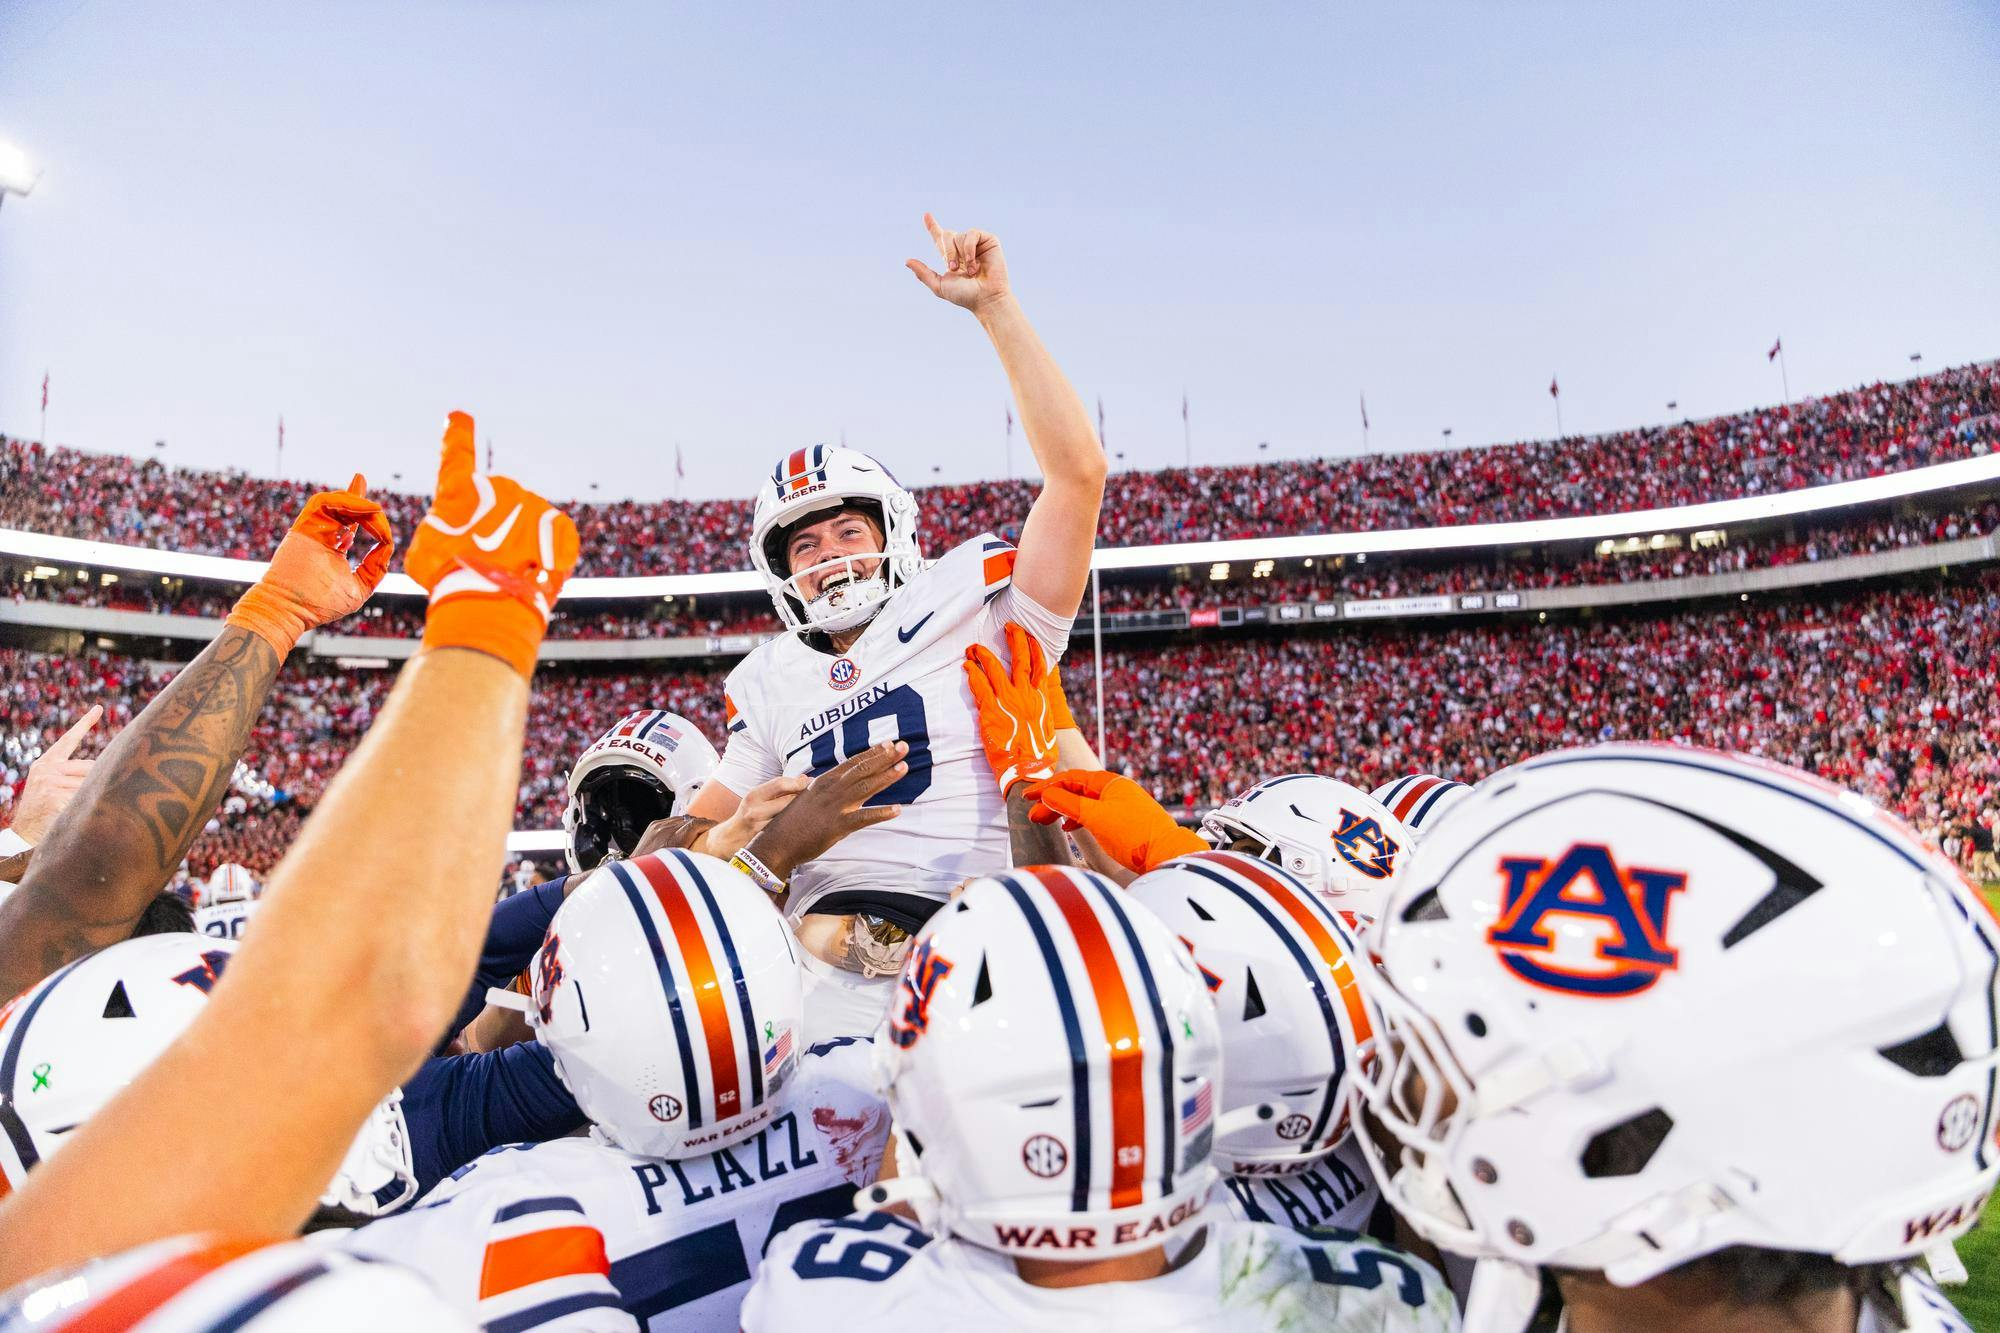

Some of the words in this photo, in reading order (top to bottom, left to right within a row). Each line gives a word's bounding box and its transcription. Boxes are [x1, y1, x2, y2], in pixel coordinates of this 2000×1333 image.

[781, 483, 826, 503] TIGERS
[832, 660, 854, 681] SEC
[800, 682, 889, 740] AUBURN
[608, 740, 667, 768] EAGLE
[650, 1096, 681, 1120] SEC
[719, 1090, 736, 1104] 52
[683, 1133, 719, 1148] WAR
[722, 1110, 768, 1136] EAGLE
[1279, 1115, 1310, 1138] SEC
[631, 1111, 818, 1216] PLAZZ
[1025, 1136, 1066, 1176] SEC
[994, 1223, 1097, 1248] WAR
[1113, 1188, 1212, 1244] EAGL
